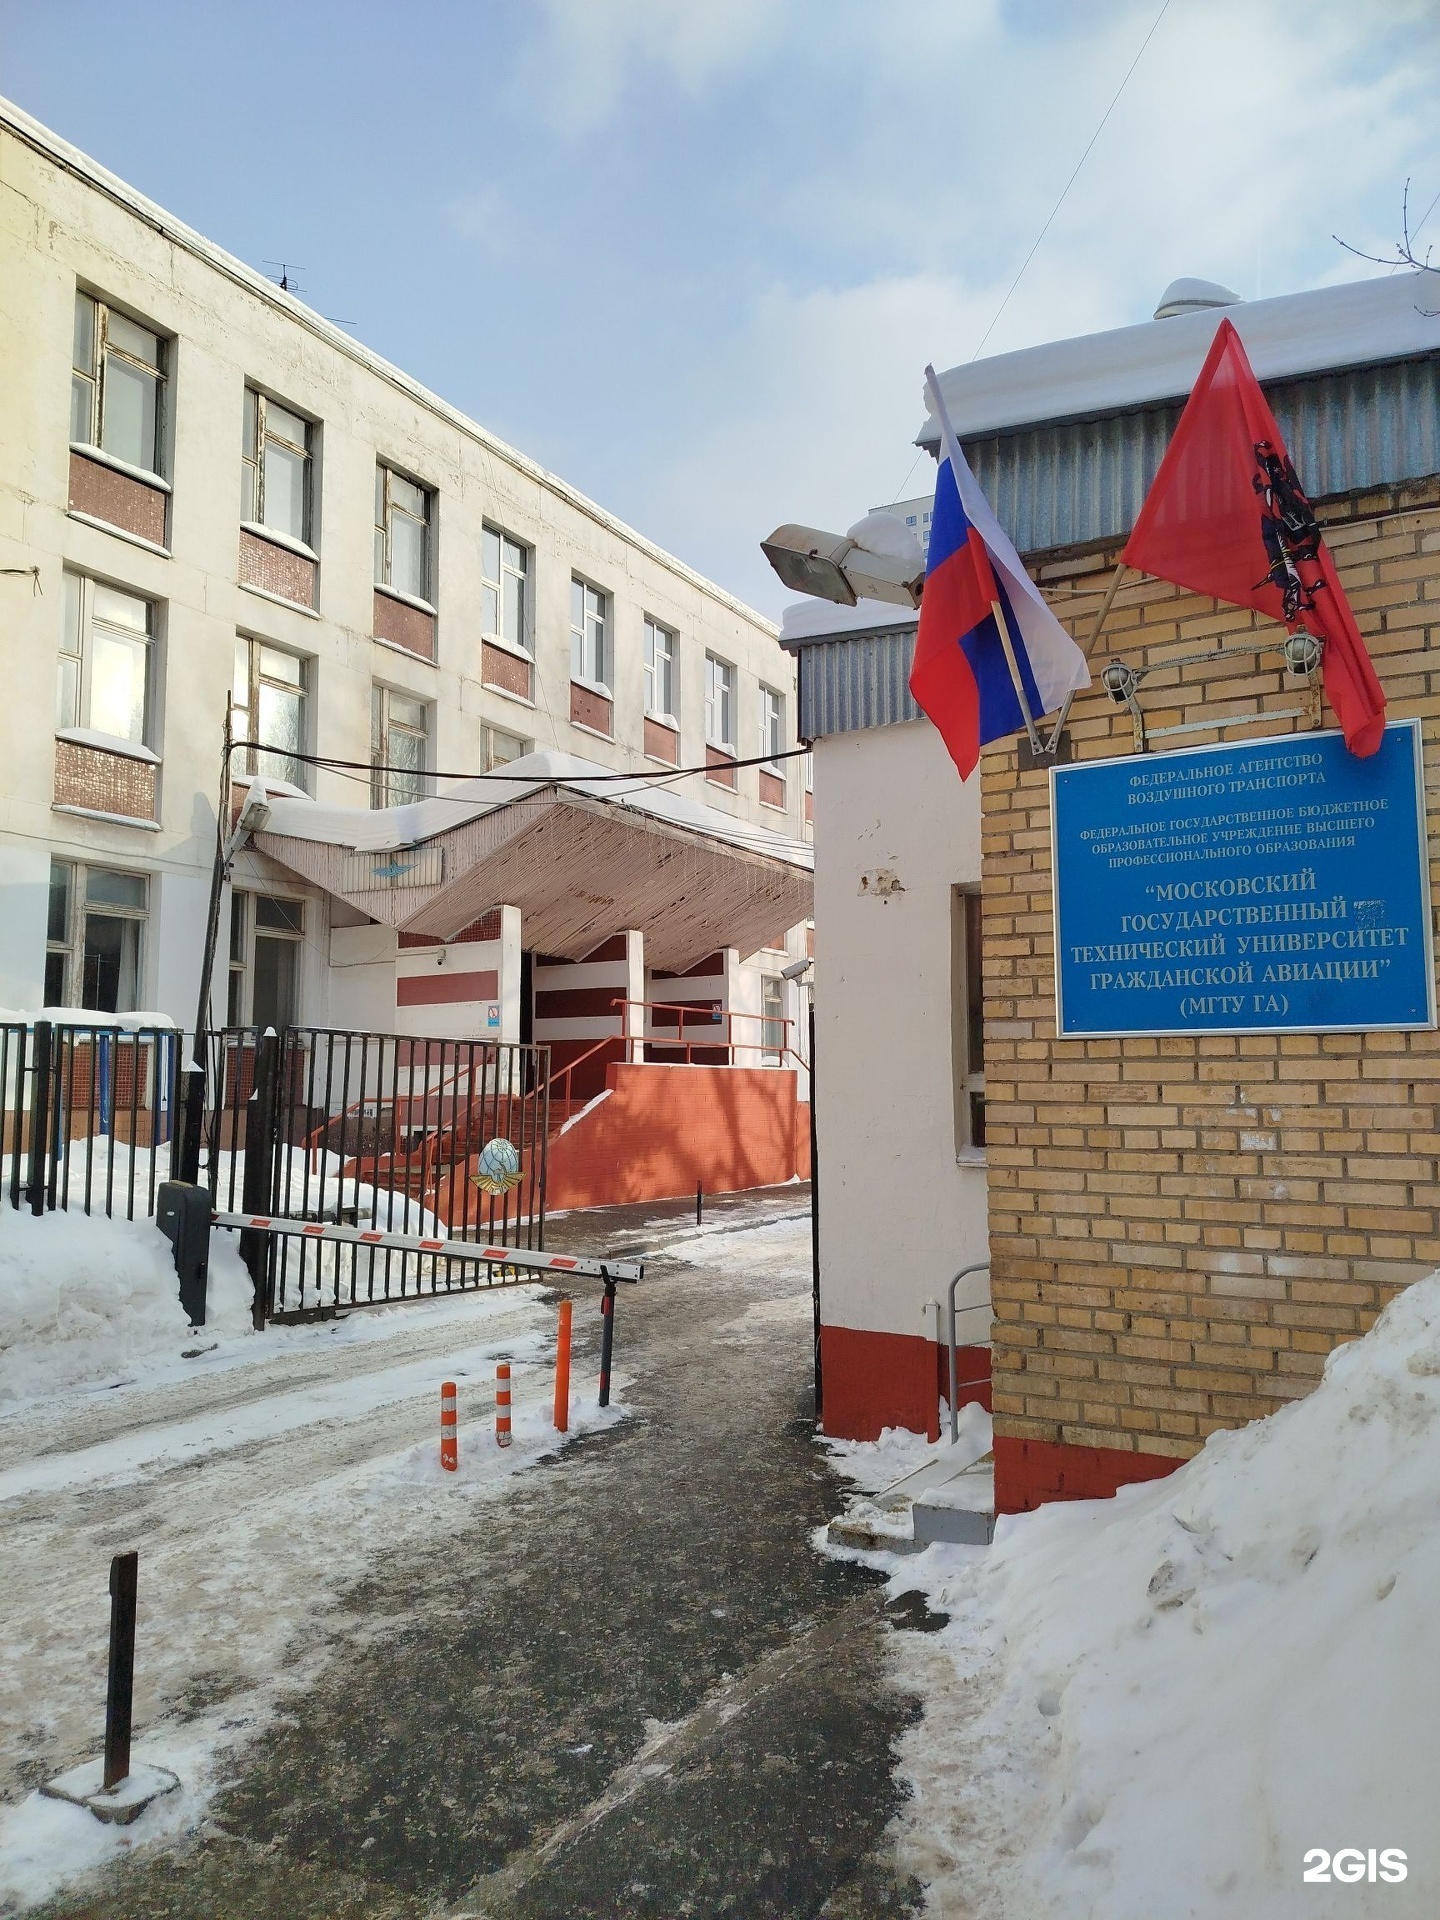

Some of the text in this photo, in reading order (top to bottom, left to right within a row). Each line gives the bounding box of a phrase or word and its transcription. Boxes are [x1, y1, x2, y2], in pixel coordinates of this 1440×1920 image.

[1129, 753, 1323, 787] ФЕДЕРАЛЬНОЕ АГЕНТСТВО
[1128, 771, 1326, 805] ВОЗДУШНОГО ТРАНСПОРТА
[1080, 798, 1389, 840] ФЕДЕРАЛЬНОЕ ГОСУДАРСТВЕННОЕ БЮДЖЕТНОЕ
[1091, 817, 1375, 855] ОБРАЗОВАТЕЛЬНОЕ УЧРЕЖДЕНИЕ ВЫСШЕГО
[1108, 835, 1356, 869] ПРОФЕССИОНАЛЬНОГО ОБРАЗОВАНИЯ
[1121, 895, 1349, 933] ГОСУДАРСТВЕННЫЙ
[1070, 927, 1409, 964] ТЕХНИЧЕСКИЙ УНИВЕРСИТЕТ
[1090, 961, 1254, 991] ГРАЖДАНСКОЙ
[1180, 993, 1289, 1019] (МГТУ ГА)
